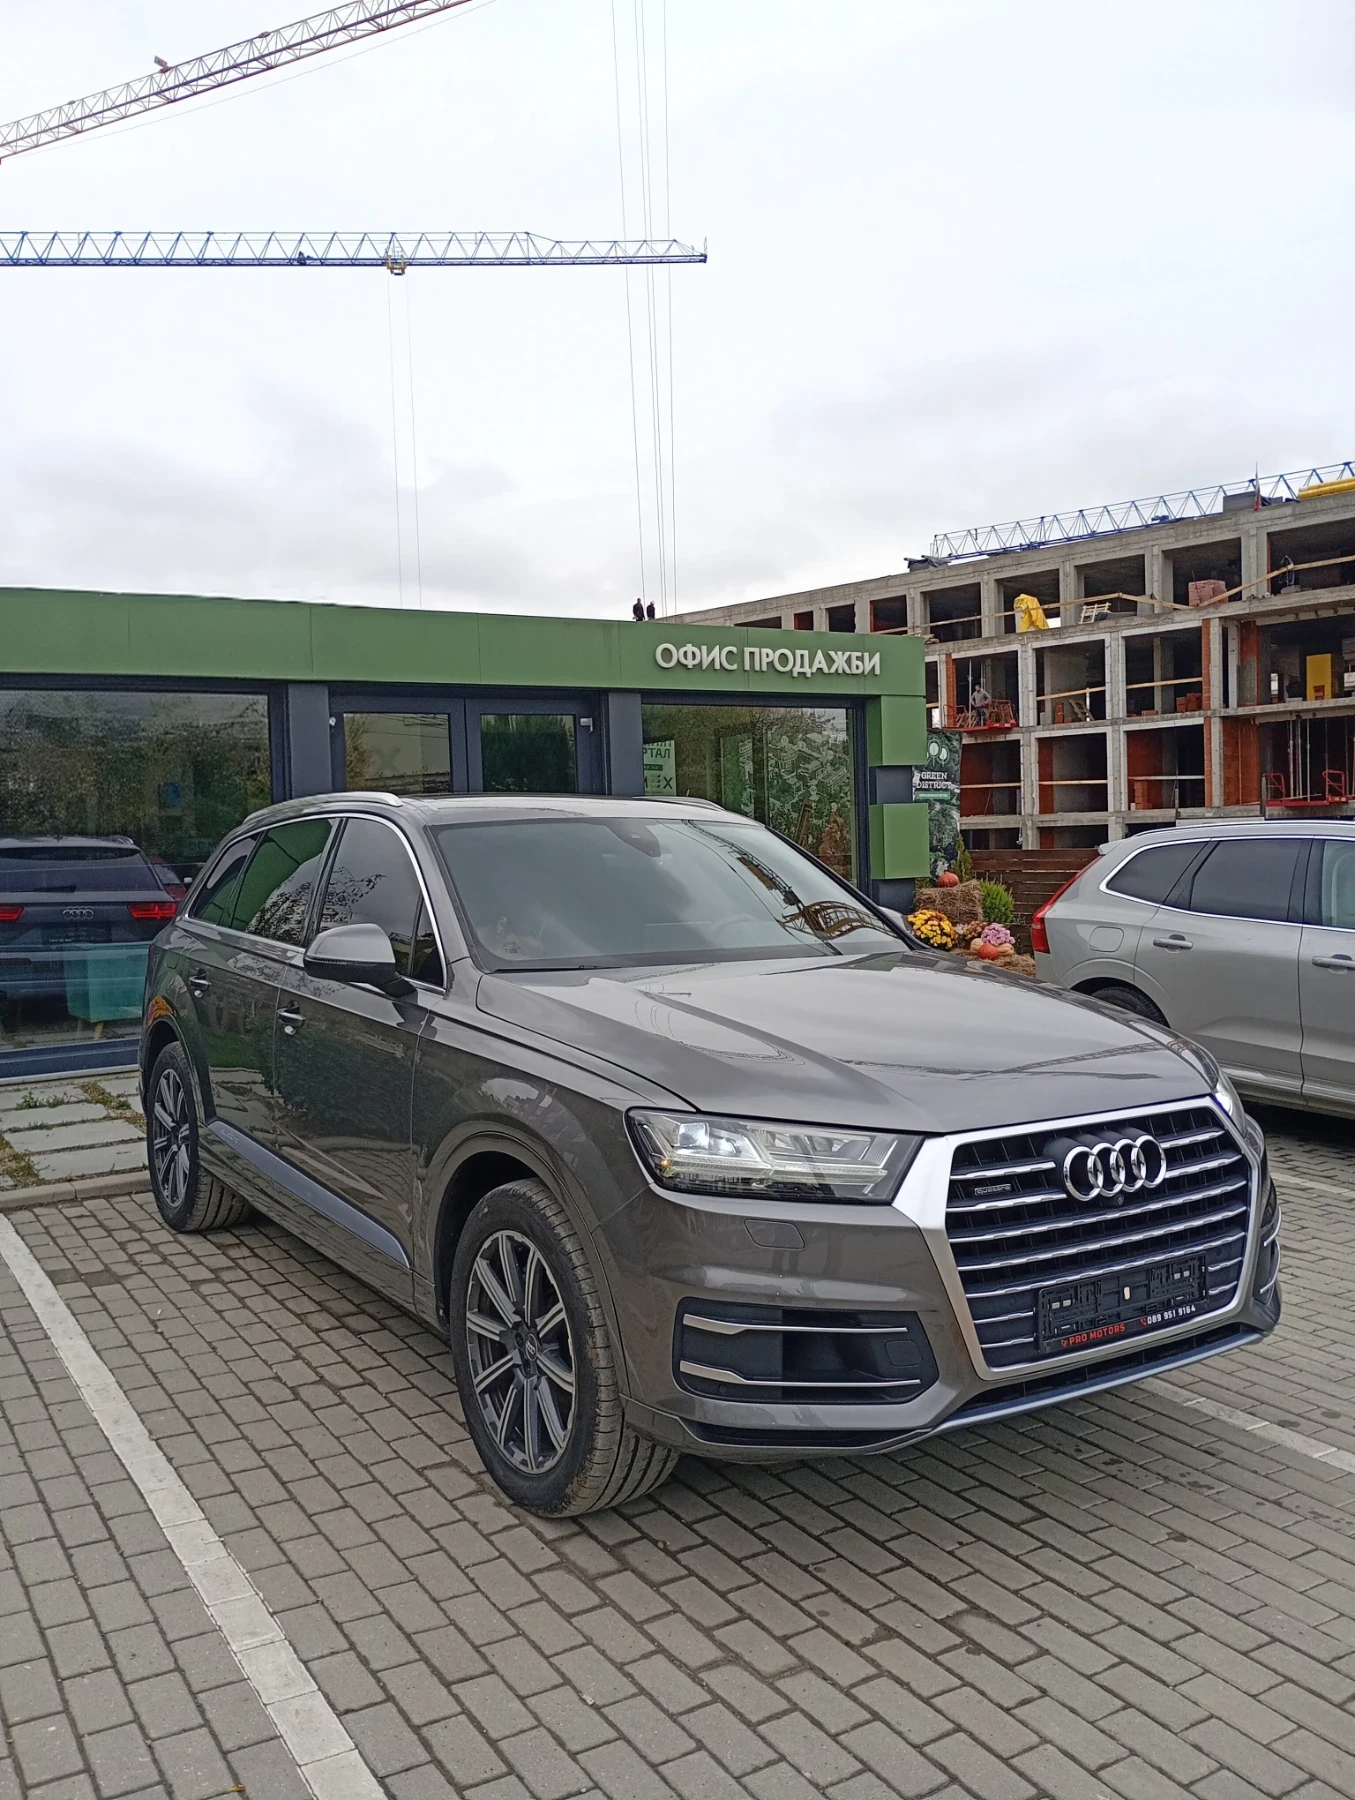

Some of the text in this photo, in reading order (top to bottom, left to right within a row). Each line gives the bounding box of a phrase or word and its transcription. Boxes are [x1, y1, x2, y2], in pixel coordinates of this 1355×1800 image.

[655, 643, 881, 678] ОФИС ПРОДАЖБИ
[916, 781, 952, 789] DISTRICT
[921, 771, 948, 780] GREEN
[1146, 1304, 1196, 1325] 089 951 9164
[1069, 1323, 1126, 1346] PRO MOTORS
